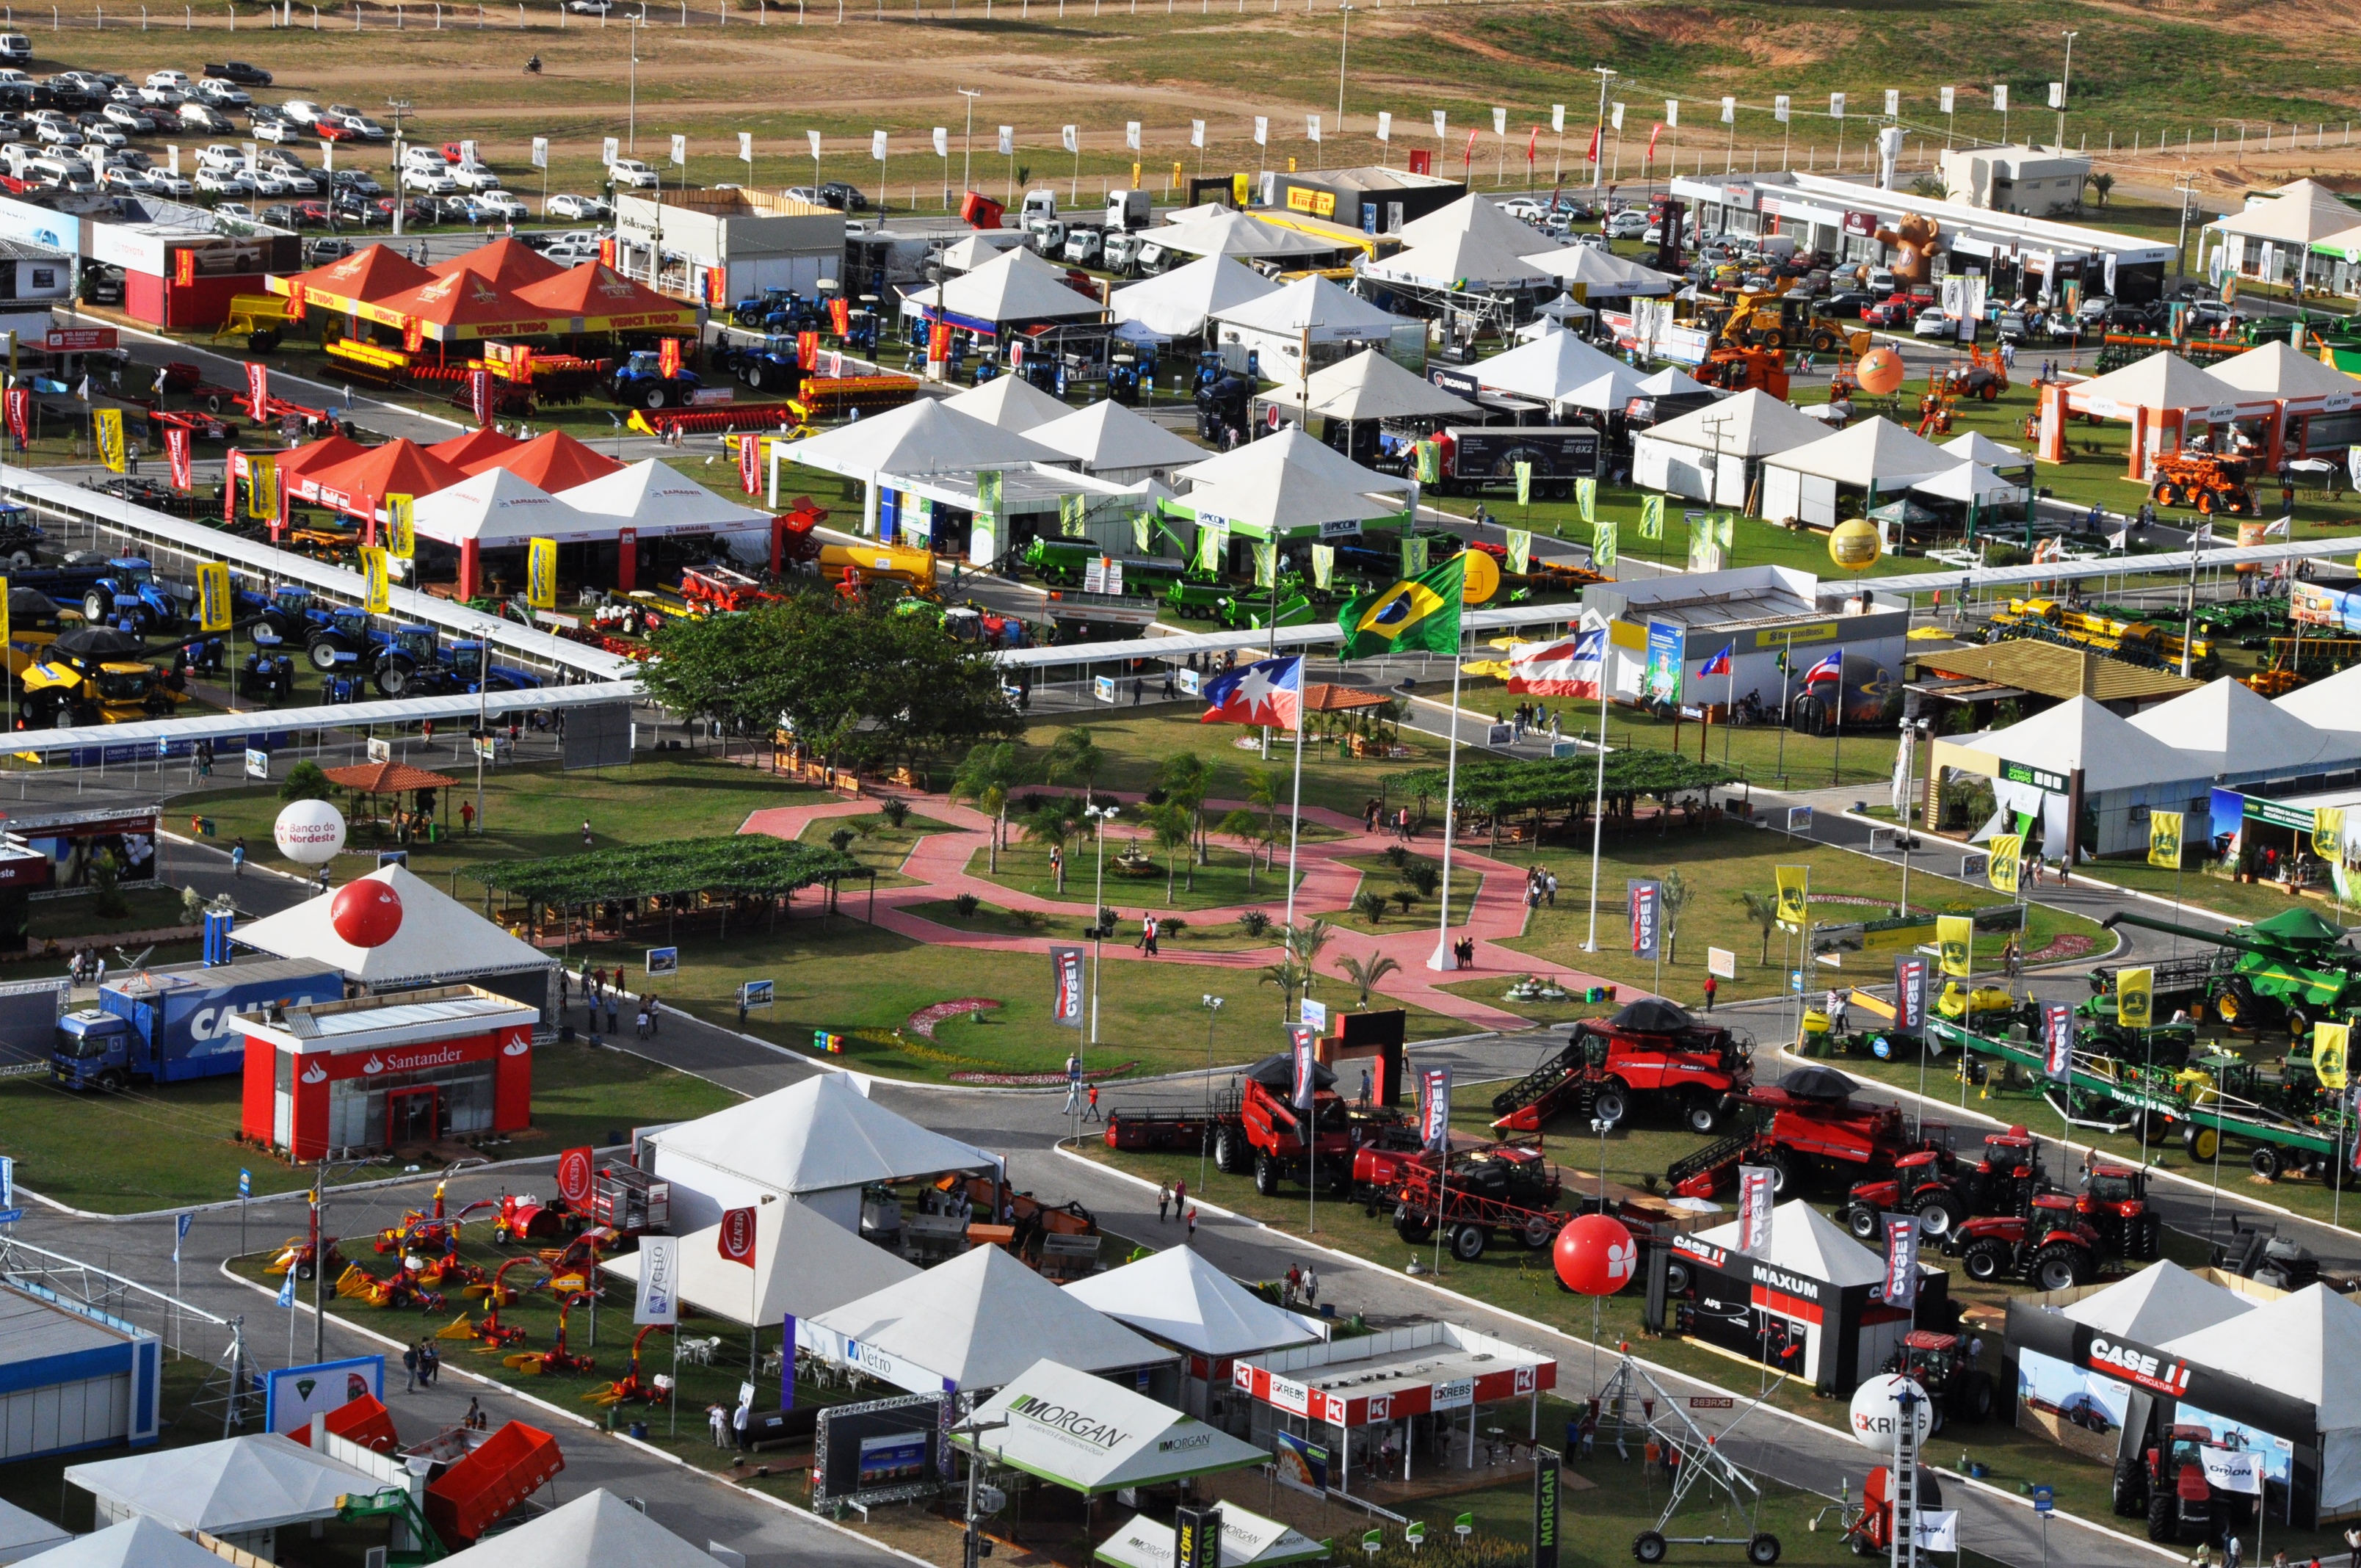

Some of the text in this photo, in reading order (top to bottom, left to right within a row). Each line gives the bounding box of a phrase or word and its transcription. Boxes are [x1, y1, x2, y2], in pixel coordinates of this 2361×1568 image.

[1292, 192, 1330, 210] PIRELLI
[621, 215, 664, 235] Volkswagen
[1667, 218, 1676, 247] Primavia
[120, 244, 145, 257] TOYOTA
[2031, 261, 2045, 272] Jeep
[2059, 264, 2075, 272] Jeep
[313, 294, 334, 306] TUDO
[374, 309, 397, 324] VENCE
[609, 313, 679, 327] VENCE TUDO
[476, 322, 548, 335] VENCE TUDO
[868, 335, 876, 348] LS
[1057, 381, 1065, 394] LS
[1444, 377, 1473, 391] SCANIA
[2096, 402, 2114, 412] jacto
[2333, 397, 2351, 407] jacto
[12, 393, 22, 427] Baldan
[2215, 408, 2233, 418] jacto
[173, 432, 182, 465] Baldan
[320, 489, 349, 508] Baldan
[1205, 512, 1225, 526] PICCIN
[1331, 519, 1357, 531] PICCIN
[675, 525, 711, 533] BAMAGRIL
[1806, 628, 1824, 636] BRASIL
[106, 748, 128, 756] CR8090
[2009, 761, 2032, 773] CASA DO
[2009, 768, 2025, 776] HOMEM
[2008, 772, 2032, 784] CAMPO
[2263, 805, 2285, 816] MINISTÉRIO
[2263, 811, 2282, 821] PECUÁRIA
[289, 822, 336, 833] Banco do
[289, 832, 336, 843] Nordeste
[1868, 918, 1907, 931] LANÇAMENTO
[388, 1048, 463, 1070] Santander
[2110, 1088, 2137, 1106] TOTAL
[2158, 1103, 2191, 1122] METROS
[576, 1158, 587, 1194] MENTA
[1619, 1214, 1639, 1224] CASE
[733, 1213, 743, 1249] MENTA
[1672, 1235, 1711, 1257] CASE
[1752, 1265, 1818, 1299] MAXUM
[1704, 1298, 1722, 1310] AFS
[860, 1345, 891, 1373] Vetro
[2090, 1338, 2159, 1377] CASE
[2135, 1373, 2174, 1393] AGRICULTURE
[1278, 1382, 1305, 1401] KREBS
[1442, 1383, 1471, 1398] KREBS
[1017, 1396, 1126, 1449] MORGAN
[1867, 1412, 1927, 1434] KRS
[1026, 1423, 1055, 1440] SEMENTES
[1059, 1434, 1104, 1458] BIOTECNOLOGIA
[1163, 1434, 1211, 1451] MORGAN
[1307, 1447, 1327, 1460] MORGAN
[1540, 1469, 1555, 1547] MORGAN
[1220, 1522, 1262, 1545] MORGAN
[1133, 1538, 1174, 1559] MORGAN
[1278, 1536, 1305, 1547] MORGAN
